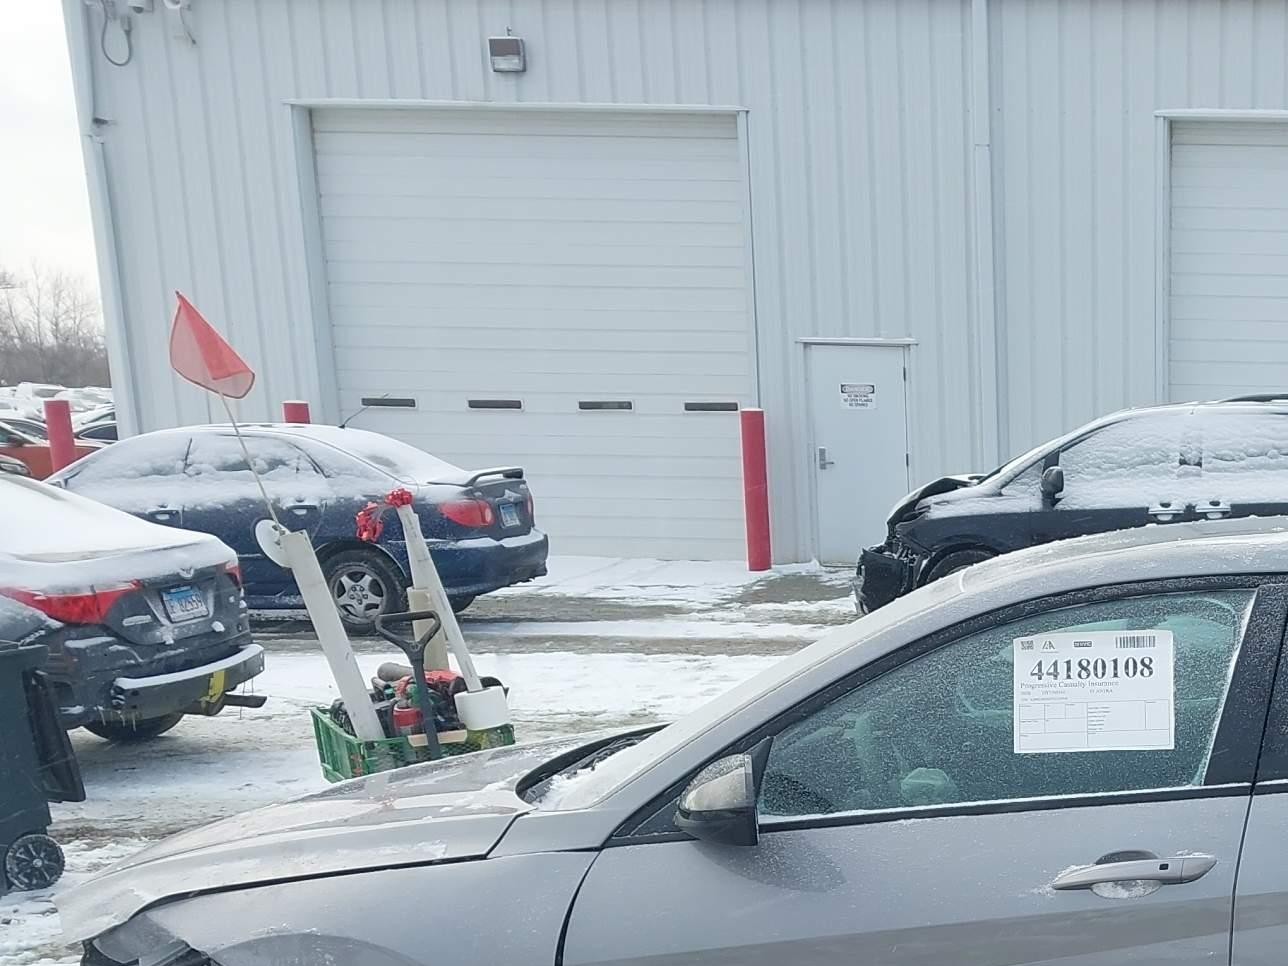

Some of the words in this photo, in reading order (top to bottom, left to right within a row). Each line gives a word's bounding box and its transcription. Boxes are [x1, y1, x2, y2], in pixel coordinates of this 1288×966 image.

[1030, 656, 1154, 681] 44180108
[1020, 682, 1058, 690] Progressive
[1058, 680, 1087, 689] Casualty
